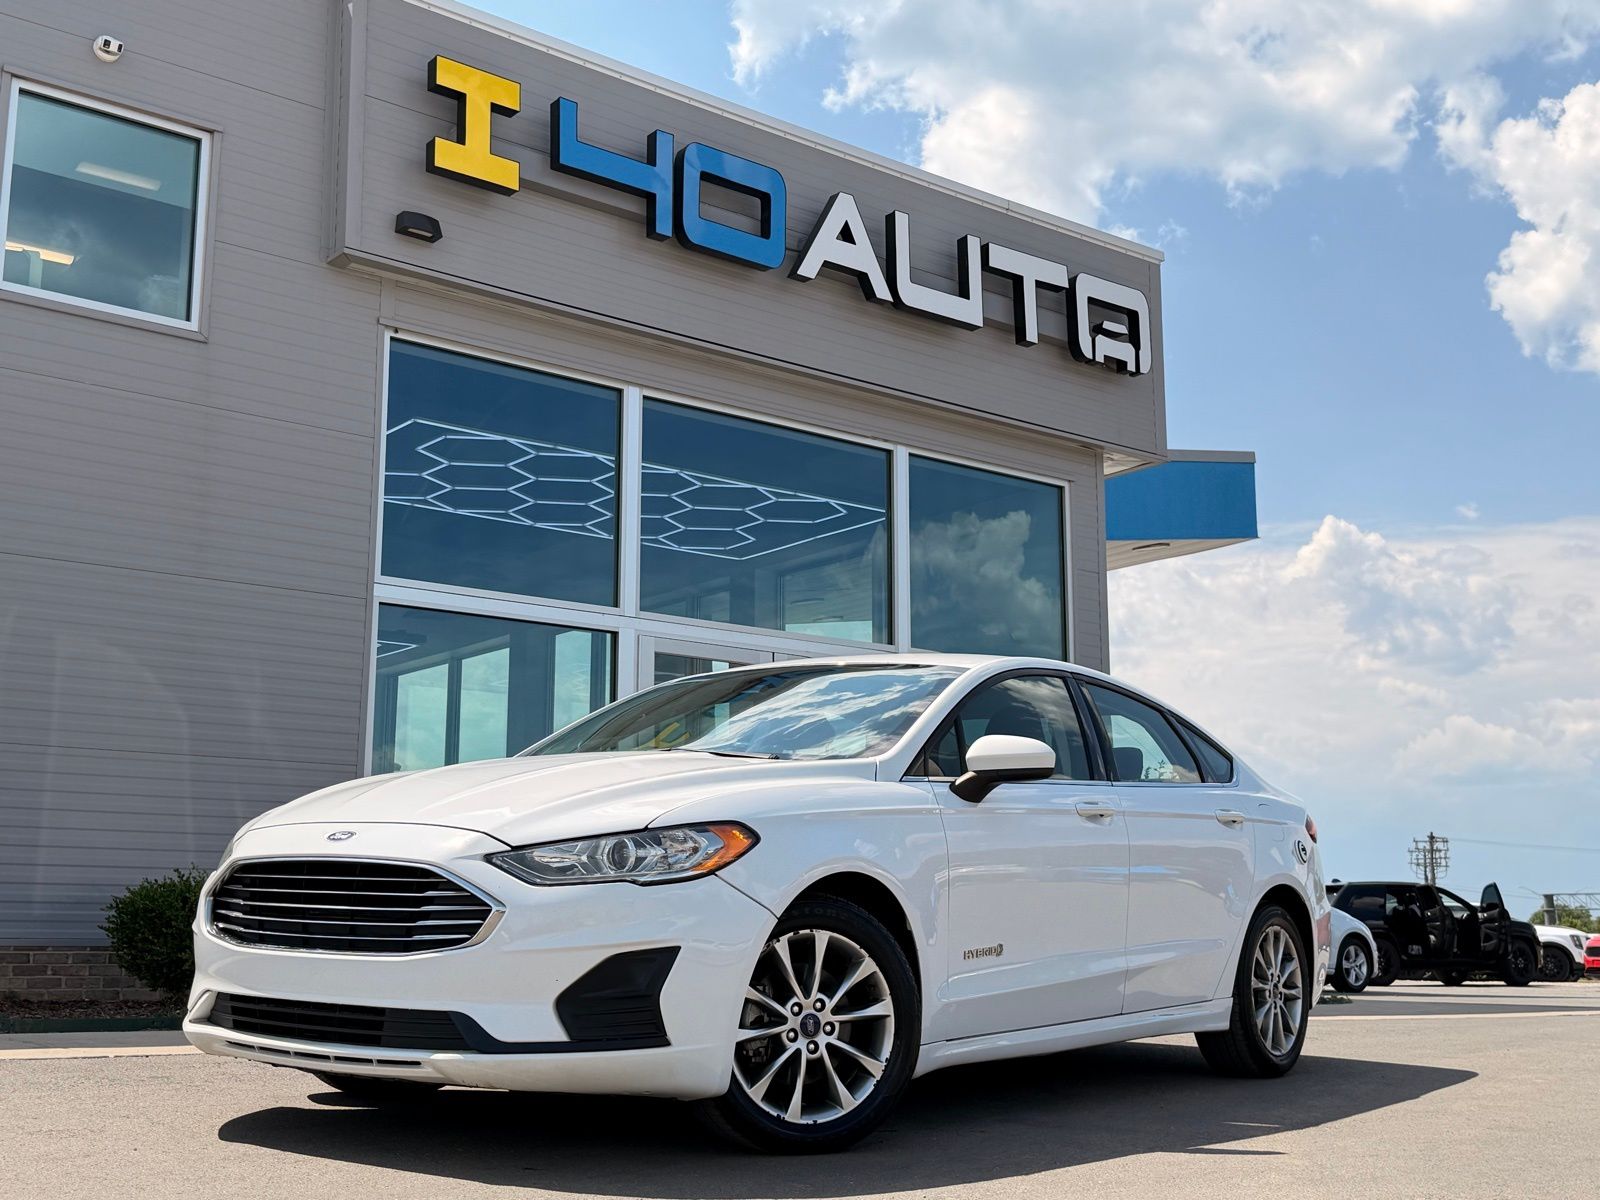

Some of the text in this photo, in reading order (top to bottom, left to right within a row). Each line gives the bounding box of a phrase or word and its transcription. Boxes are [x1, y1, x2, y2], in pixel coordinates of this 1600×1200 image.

[426, 55, 1152, 376] I 40 AUTO
[963, 946, 997, 960] HYBRID
